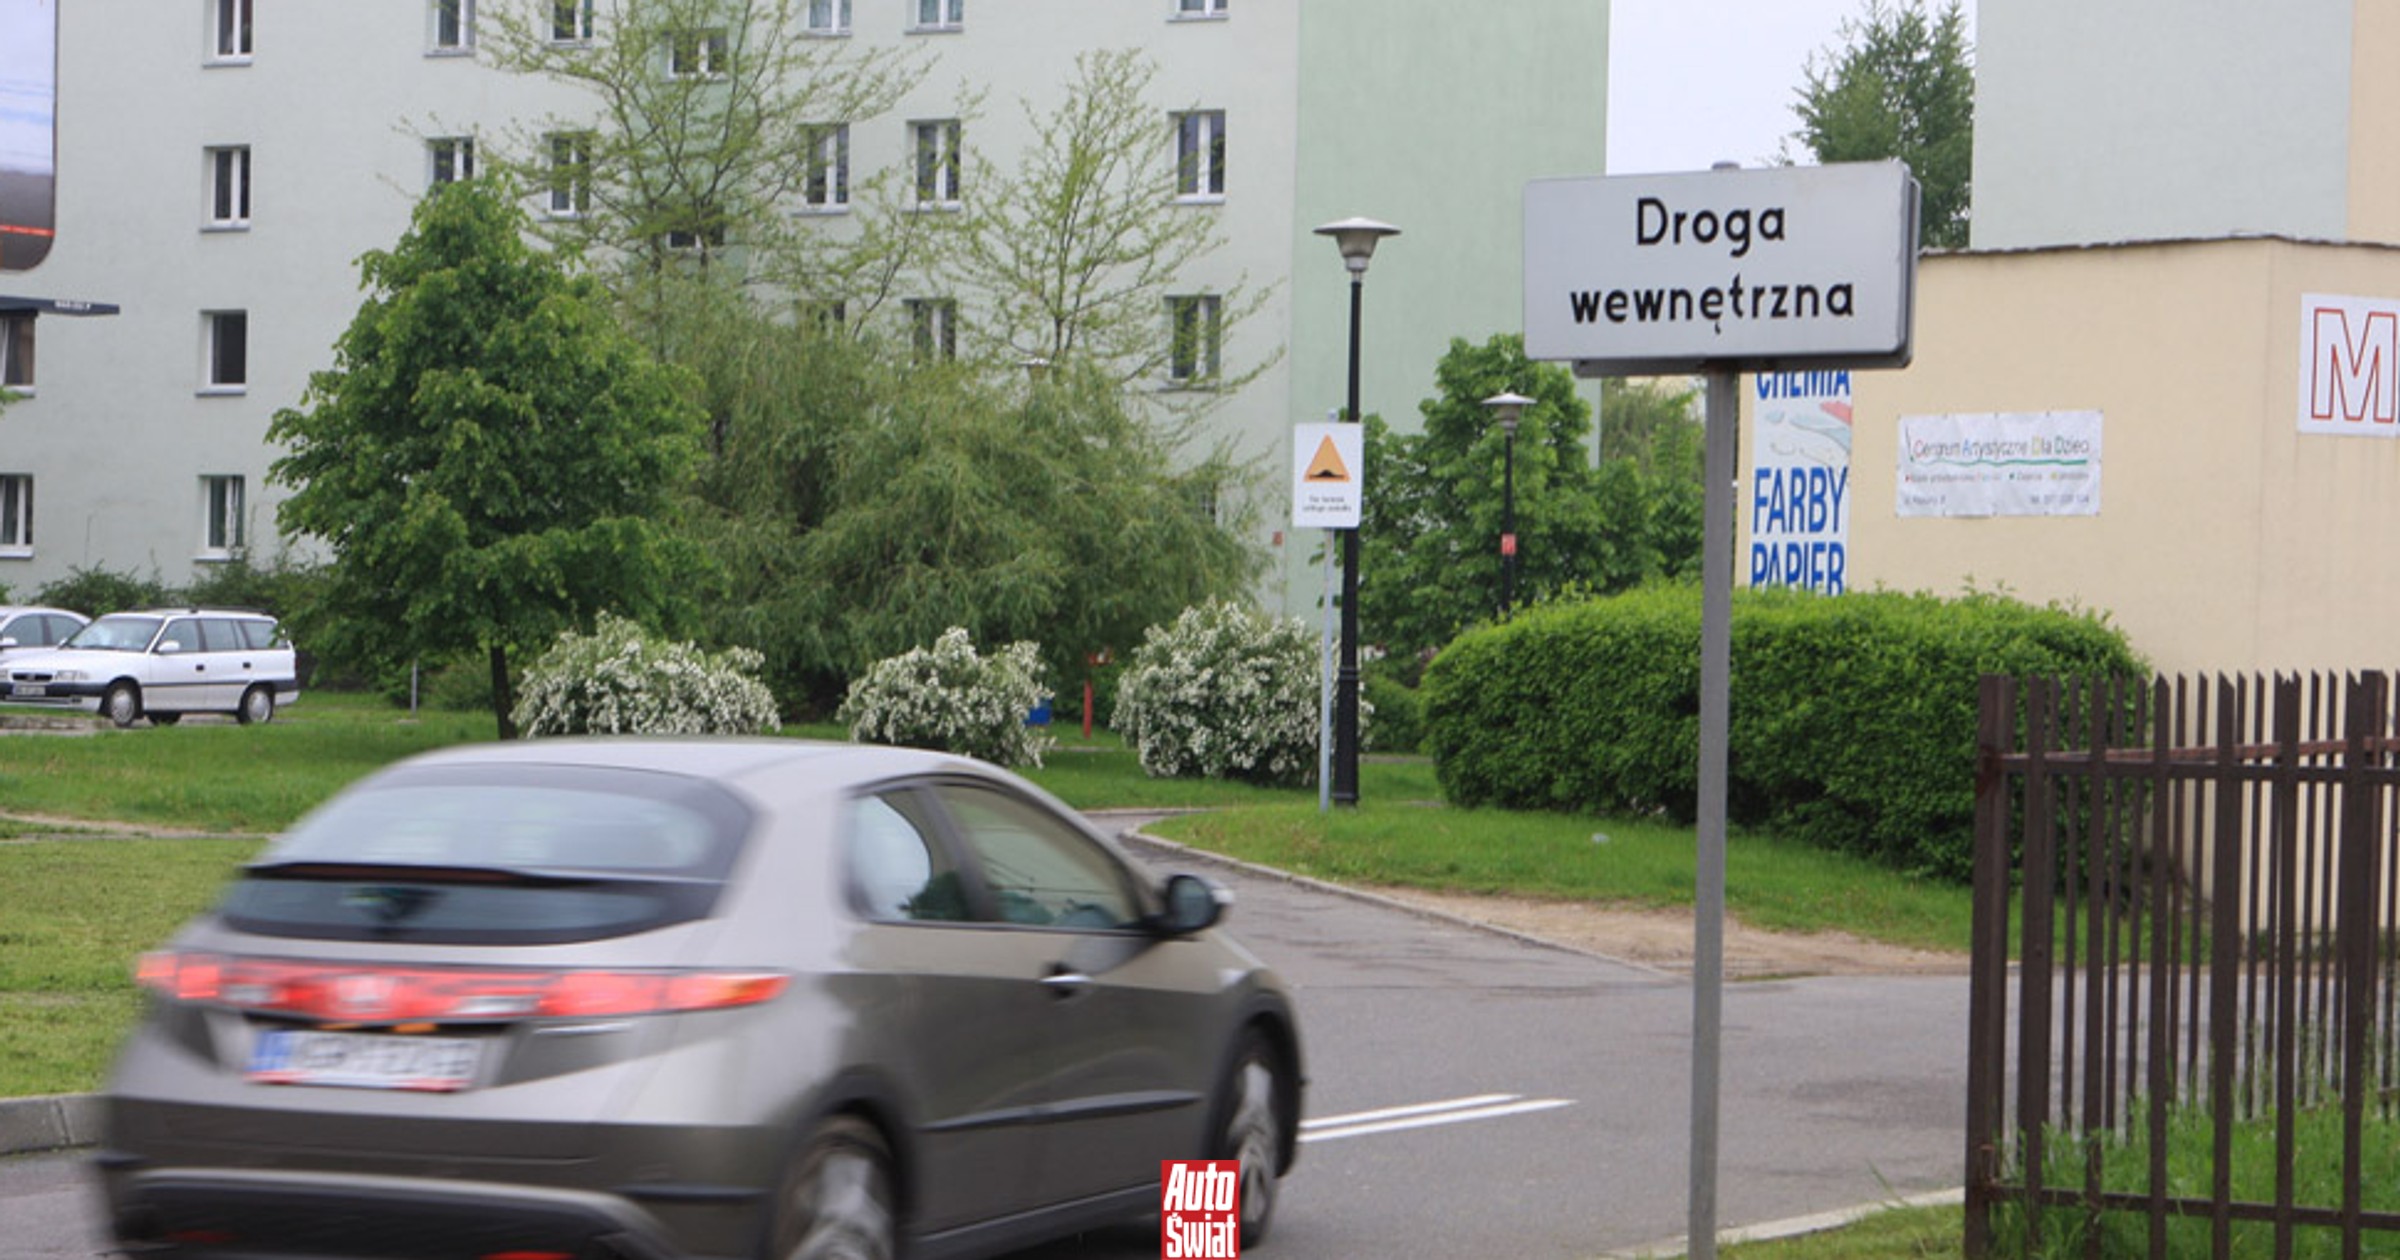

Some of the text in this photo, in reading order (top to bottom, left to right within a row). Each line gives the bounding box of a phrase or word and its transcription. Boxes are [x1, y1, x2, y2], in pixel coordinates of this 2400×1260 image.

[1636, 197, 1786, 258] Droga
[1570, 272, 1854, 335] wewnętrzna
[1752, 465, 1848, 534] FARBY
[1750, 541, 1844, 597] PAPIER
